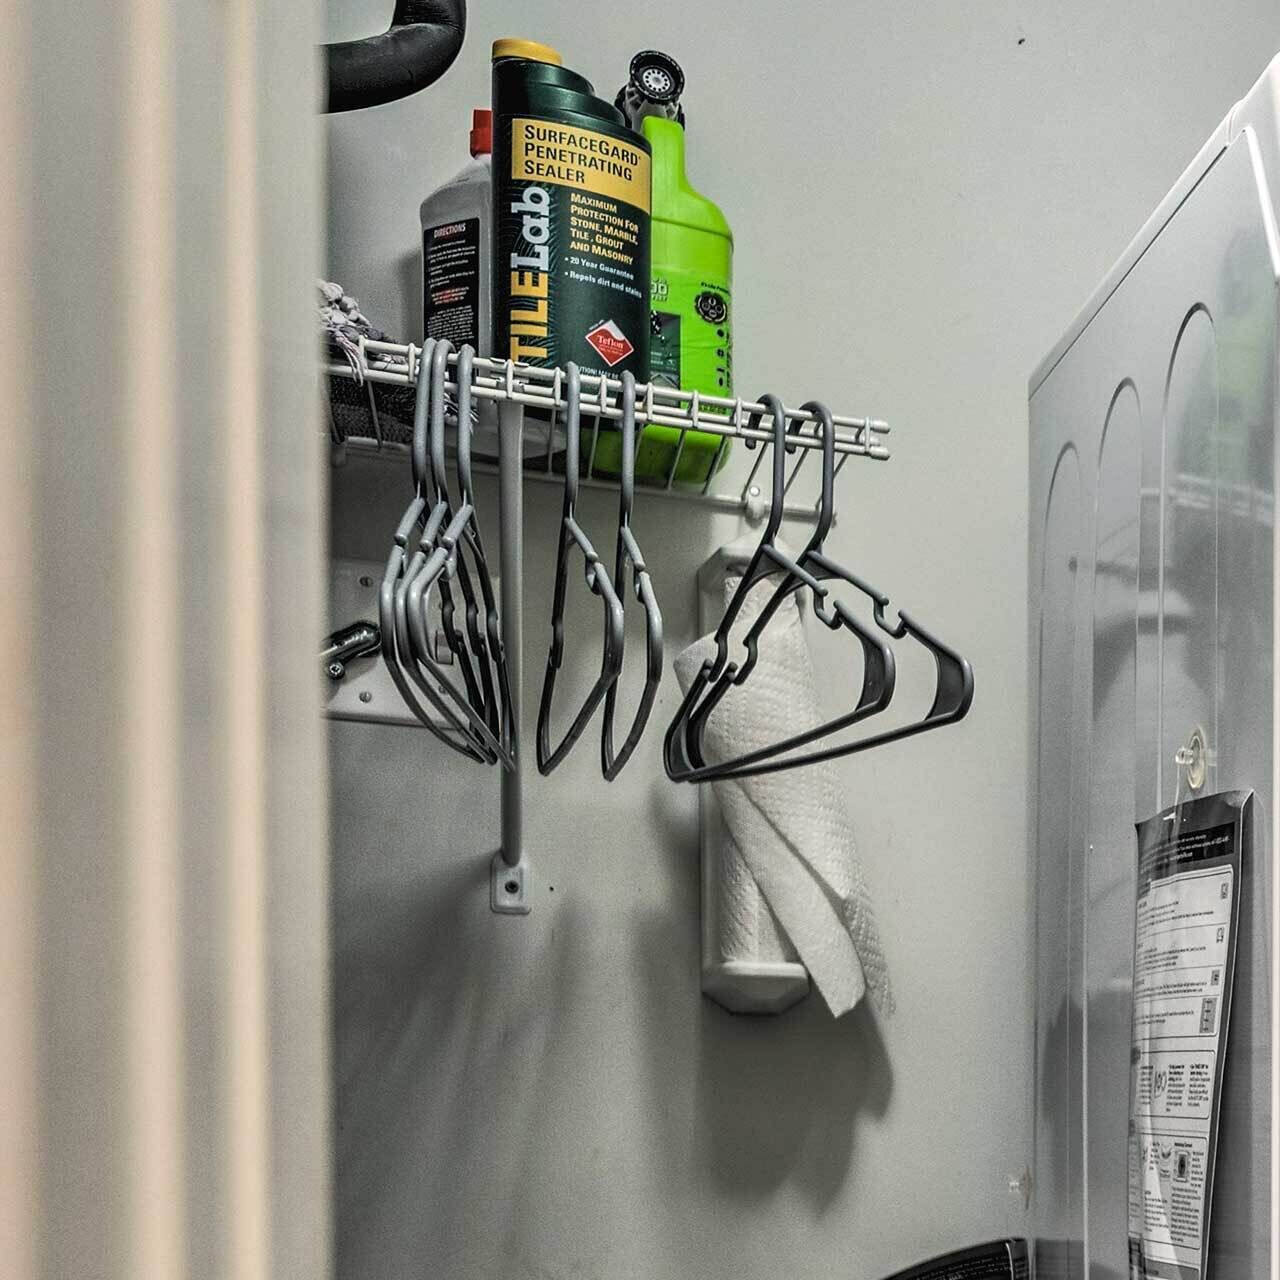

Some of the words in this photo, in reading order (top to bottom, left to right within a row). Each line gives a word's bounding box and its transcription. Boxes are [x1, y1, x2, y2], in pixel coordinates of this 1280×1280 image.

[524, 142, 633, 181] PENETRATING
[524, 160, 585, 183] SEALER
[570, 192, 617, 213] MAXIMUM
[570, 204, 624, 227] PROTECTION
[433, 222, 466, 239] DIRECTIONS
[595, 234, 624, 250] GROUT
[570, 241, 590, 252] AND
[591, 244, 633, 265] MASONRY
[581, 258, 598, 269] Year
[510, 186, 550, 362] TILELab
[570, 270, 596, 283] Repels
[597, 277, 610, 287] dirt
[611, 282, 625, 291] and
[597, 334, 624, 349] Teflon
